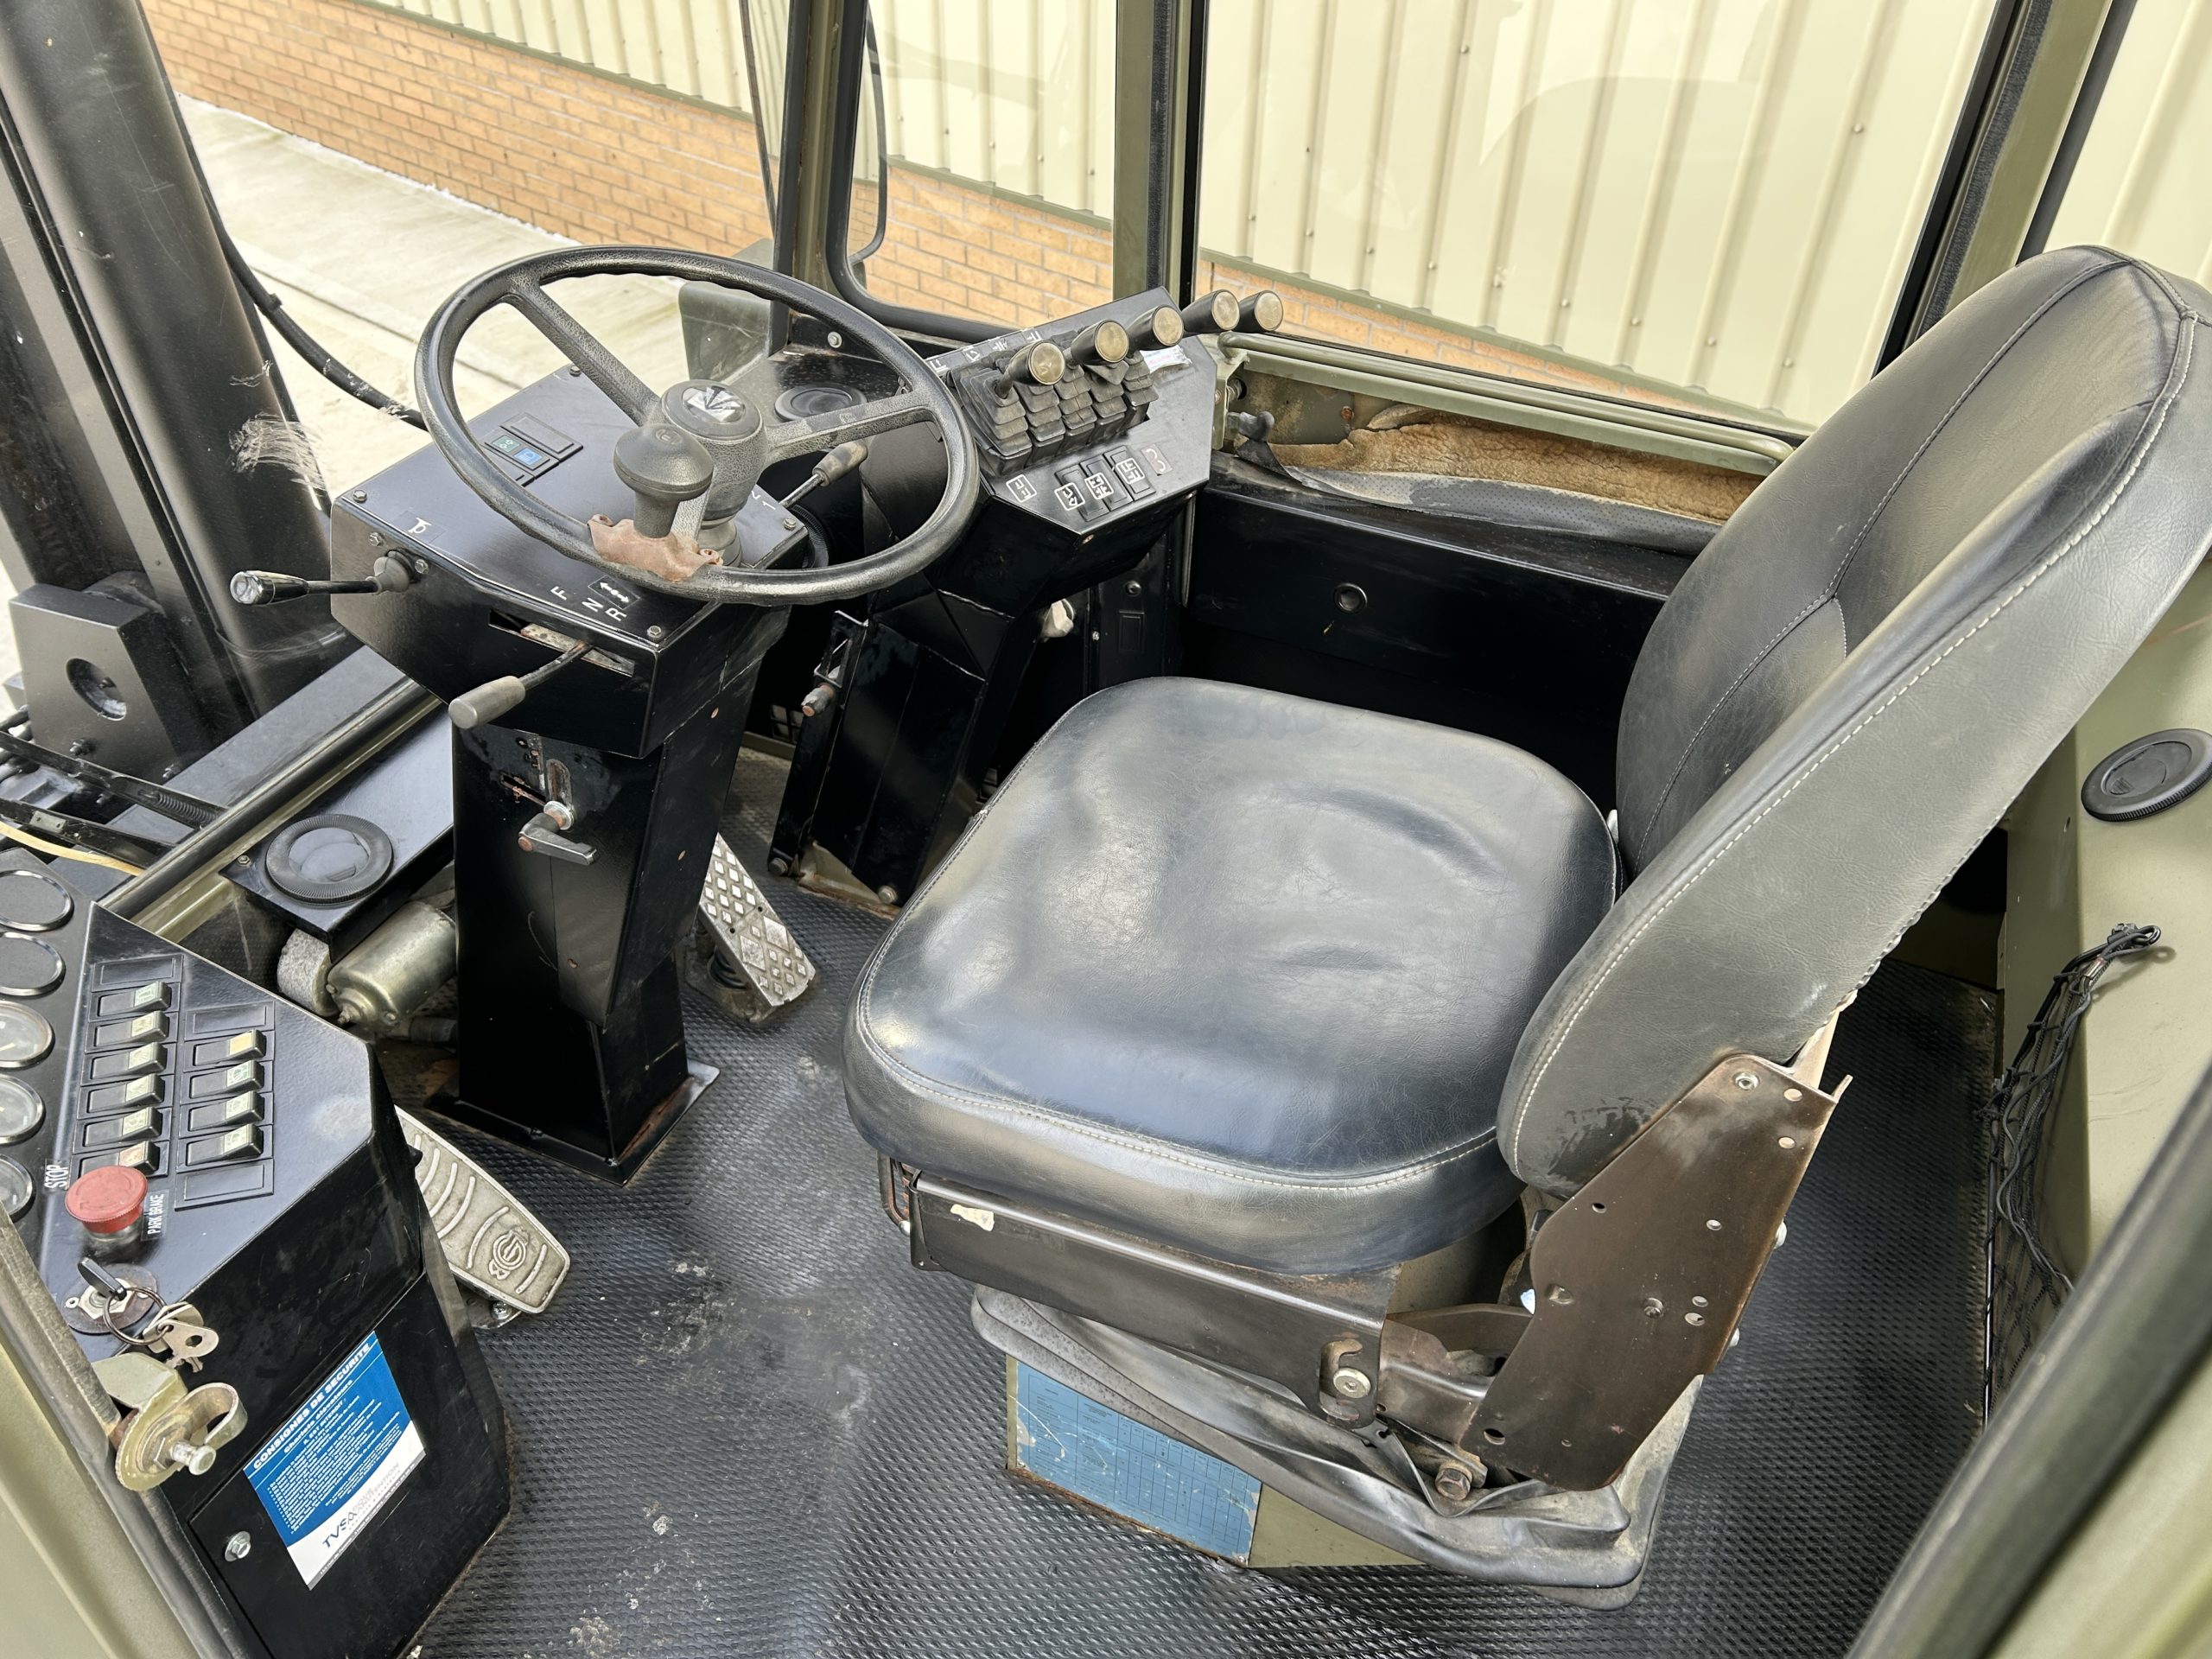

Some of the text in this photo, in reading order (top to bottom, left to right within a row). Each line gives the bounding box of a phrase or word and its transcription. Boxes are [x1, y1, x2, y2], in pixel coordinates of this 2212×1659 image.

[550, 585, 569, 601] F
[582, 597, 604, 613] N
[605, 608, 627, 622] R
[44, 1164, 69, 1189] STOP
[147, 1193, 163, 1235] PARK BRAKE
[253, 1408, 310, 1470] CONSIGNES
[310, 1392, 325, 1409] DE
